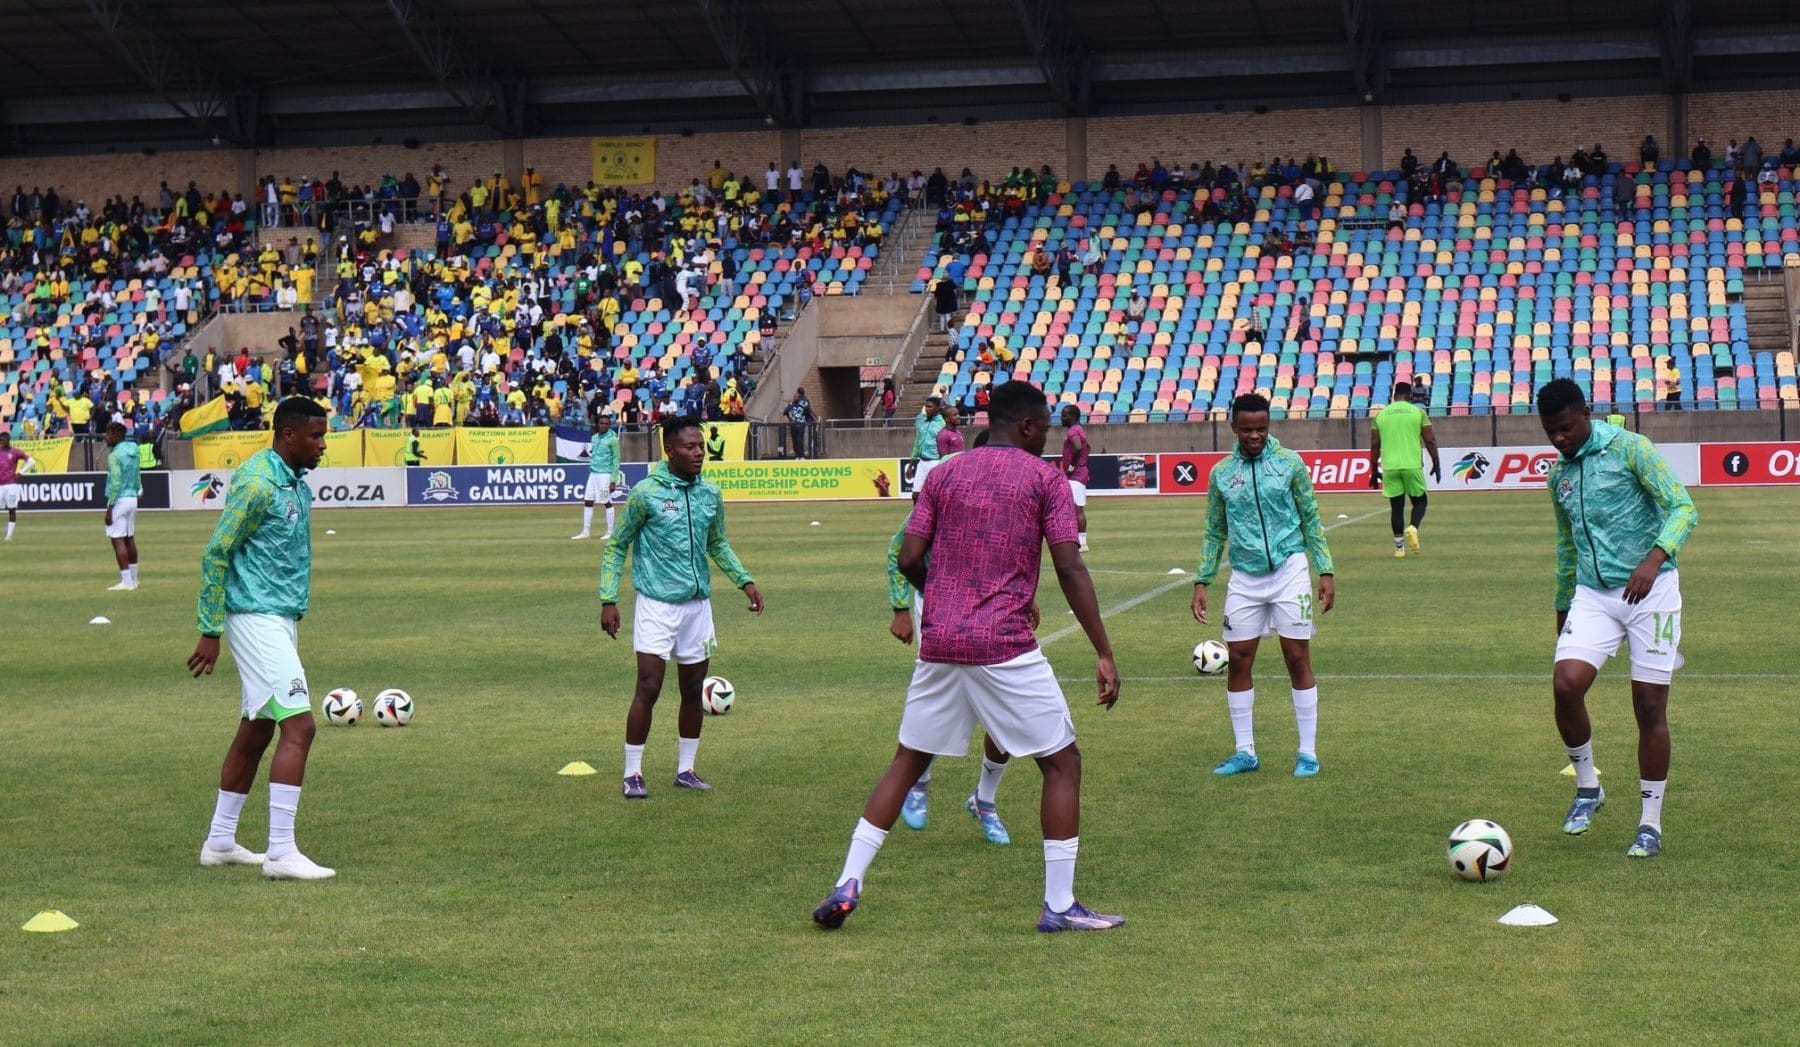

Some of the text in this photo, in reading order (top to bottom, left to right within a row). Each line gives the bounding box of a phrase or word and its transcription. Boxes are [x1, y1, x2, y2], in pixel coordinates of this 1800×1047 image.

[422, 431, 450, 439] BRANCH
[508, 429, 537, 437] BRANCH
[487, 468, 566, 484] MARUMO
[772, 466, 852, 478] SUNDOWNS
[716, 477, 840, 490] EMBERSHIP CARD
[469, 484, 585, 501] GALLANTS FC
[1296, 593, 1312, 620] 12
[1653, 612, 1674, 647] 14
